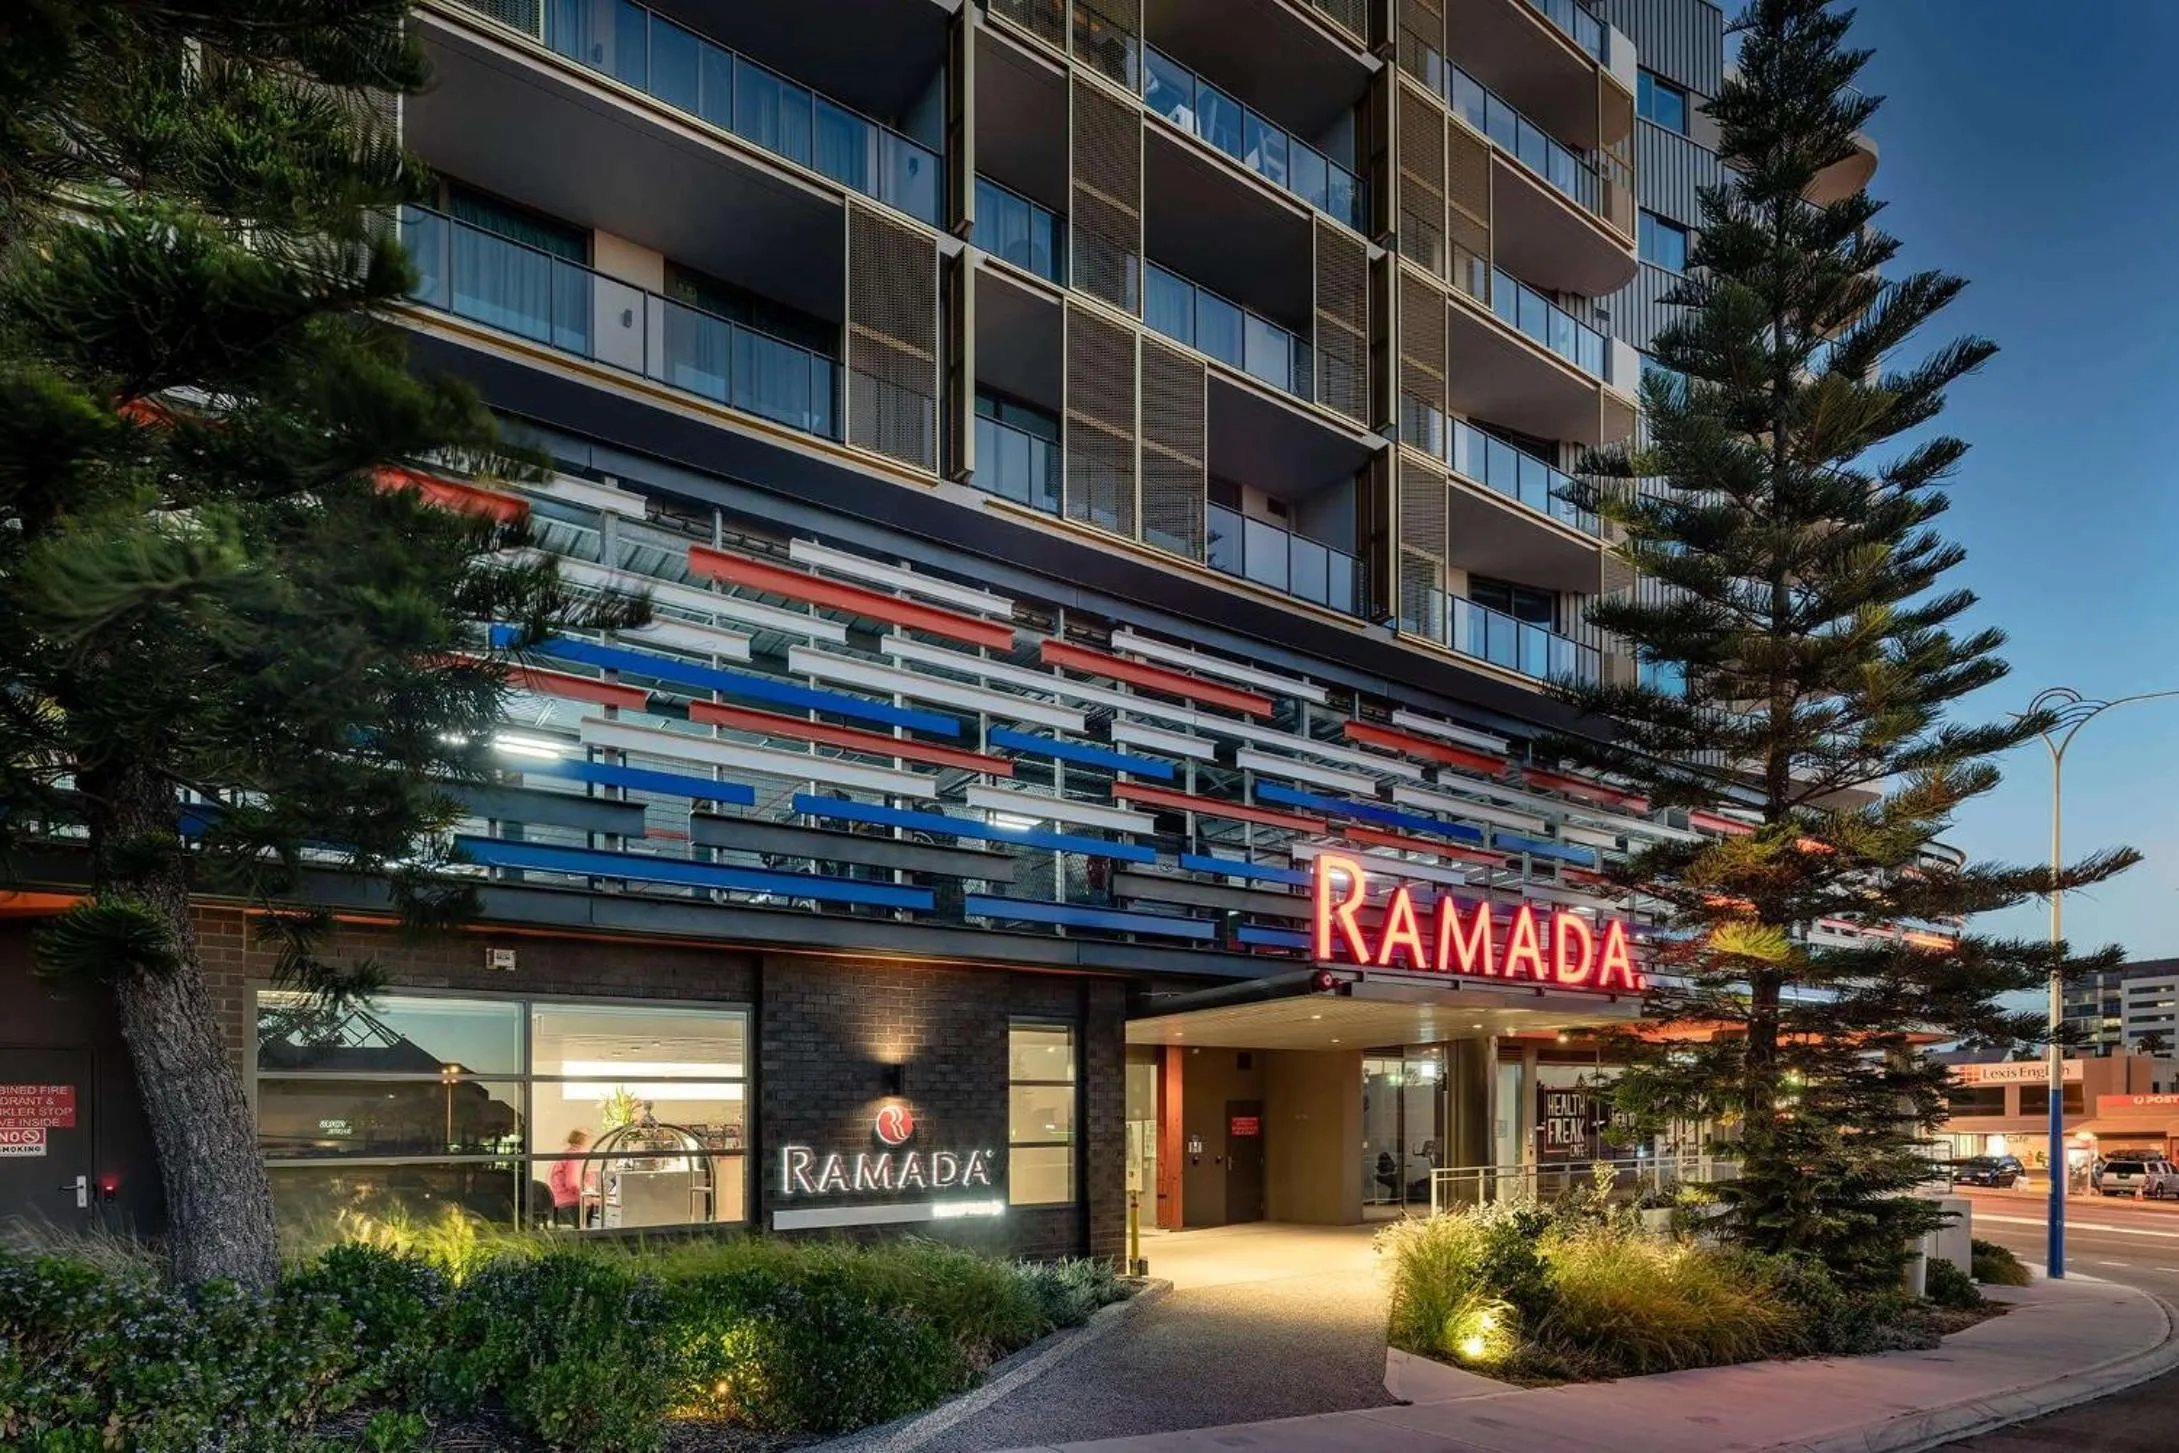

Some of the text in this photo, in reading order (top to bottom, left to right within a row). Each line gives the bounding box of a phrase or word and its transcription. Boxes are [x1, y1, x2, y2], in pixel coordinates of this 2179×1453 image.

[1313, 853, 1642, 991] RAMADA
[1983, 1063, 2070, 1080] Lexis Englh
[40, 1086, 68, 1095] FIRE
[46, 1097, 54, 1105] &
[1547, 1093, 1586, 1117] HEALTH
[2145, 1095, 2179, 1105] POST
[0, 1106, 73, 1116] KLER STOP
[20, 1118, 60, 1127] INSIDE
[1548, 1117, 1586, 1144] FREAK
[0, 1131, 20, 1143] NO
[784, 1146, 991, 1194] RAMADA
